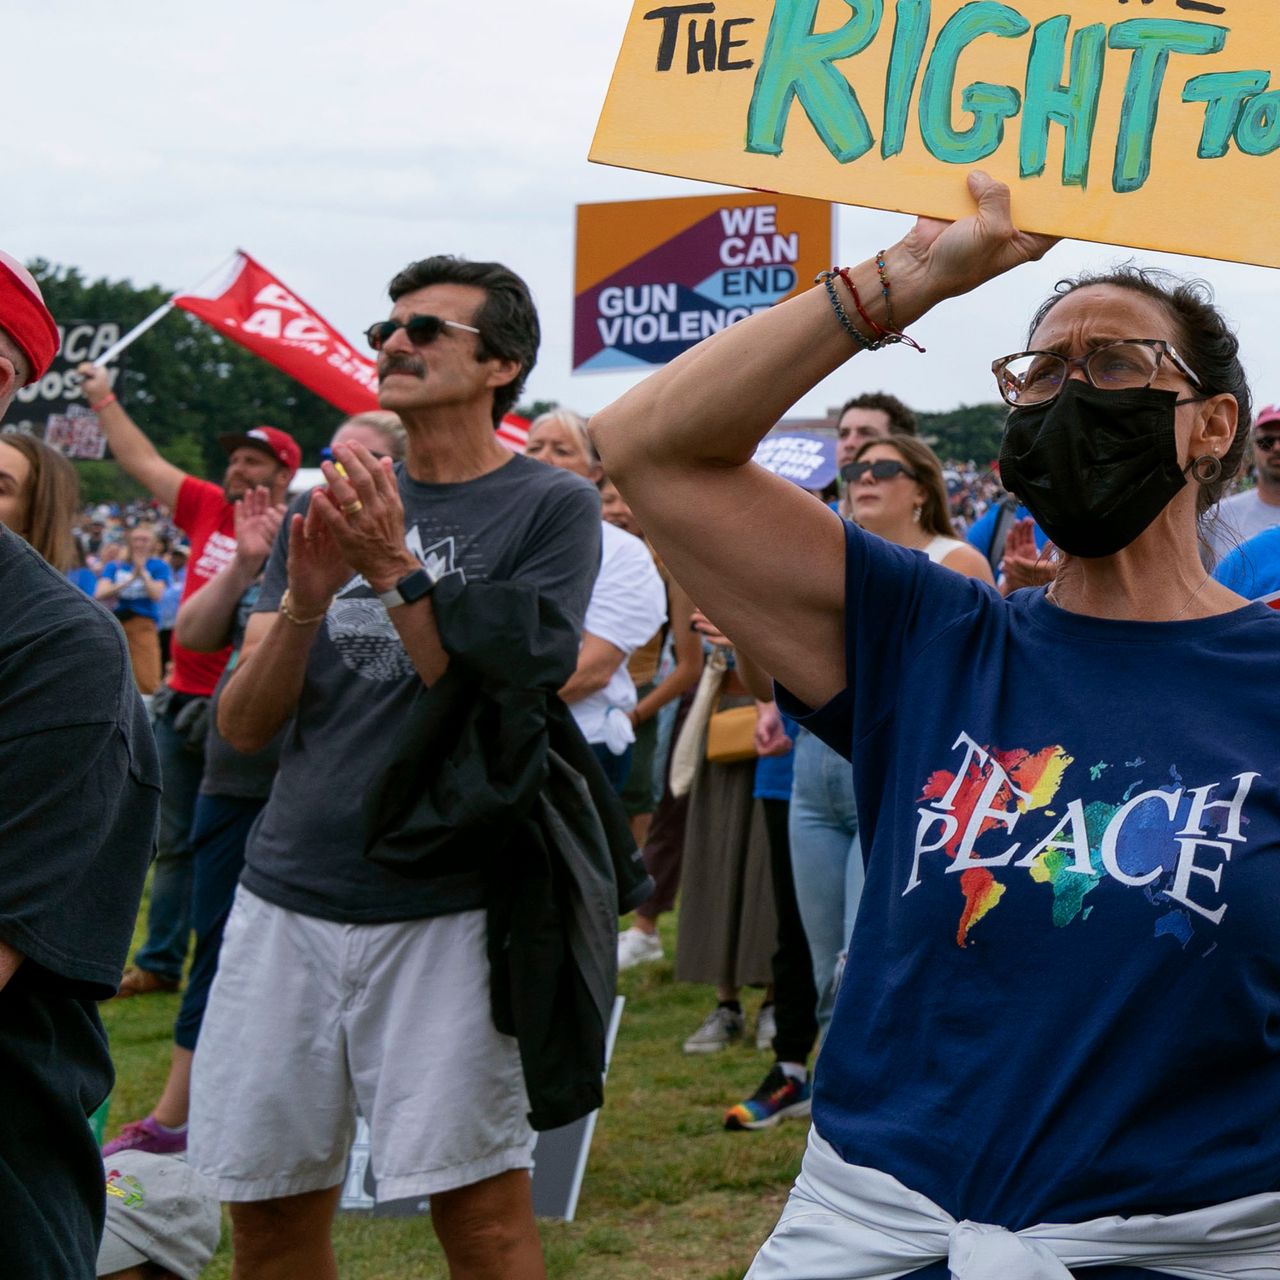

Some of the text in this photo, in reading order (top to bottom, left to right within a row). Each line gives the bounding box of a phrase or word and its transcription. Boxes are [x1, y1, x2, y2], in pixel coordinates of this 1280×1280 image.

[643, 2, 756, 75] THE
[720, 206, 777, 236] WE
[719, 233, 798, 266] CAN
[722, 267, 797, 298] END
[597, 283, 677, 318] GUN
[596, 304, 771, 347] VIOLENC
